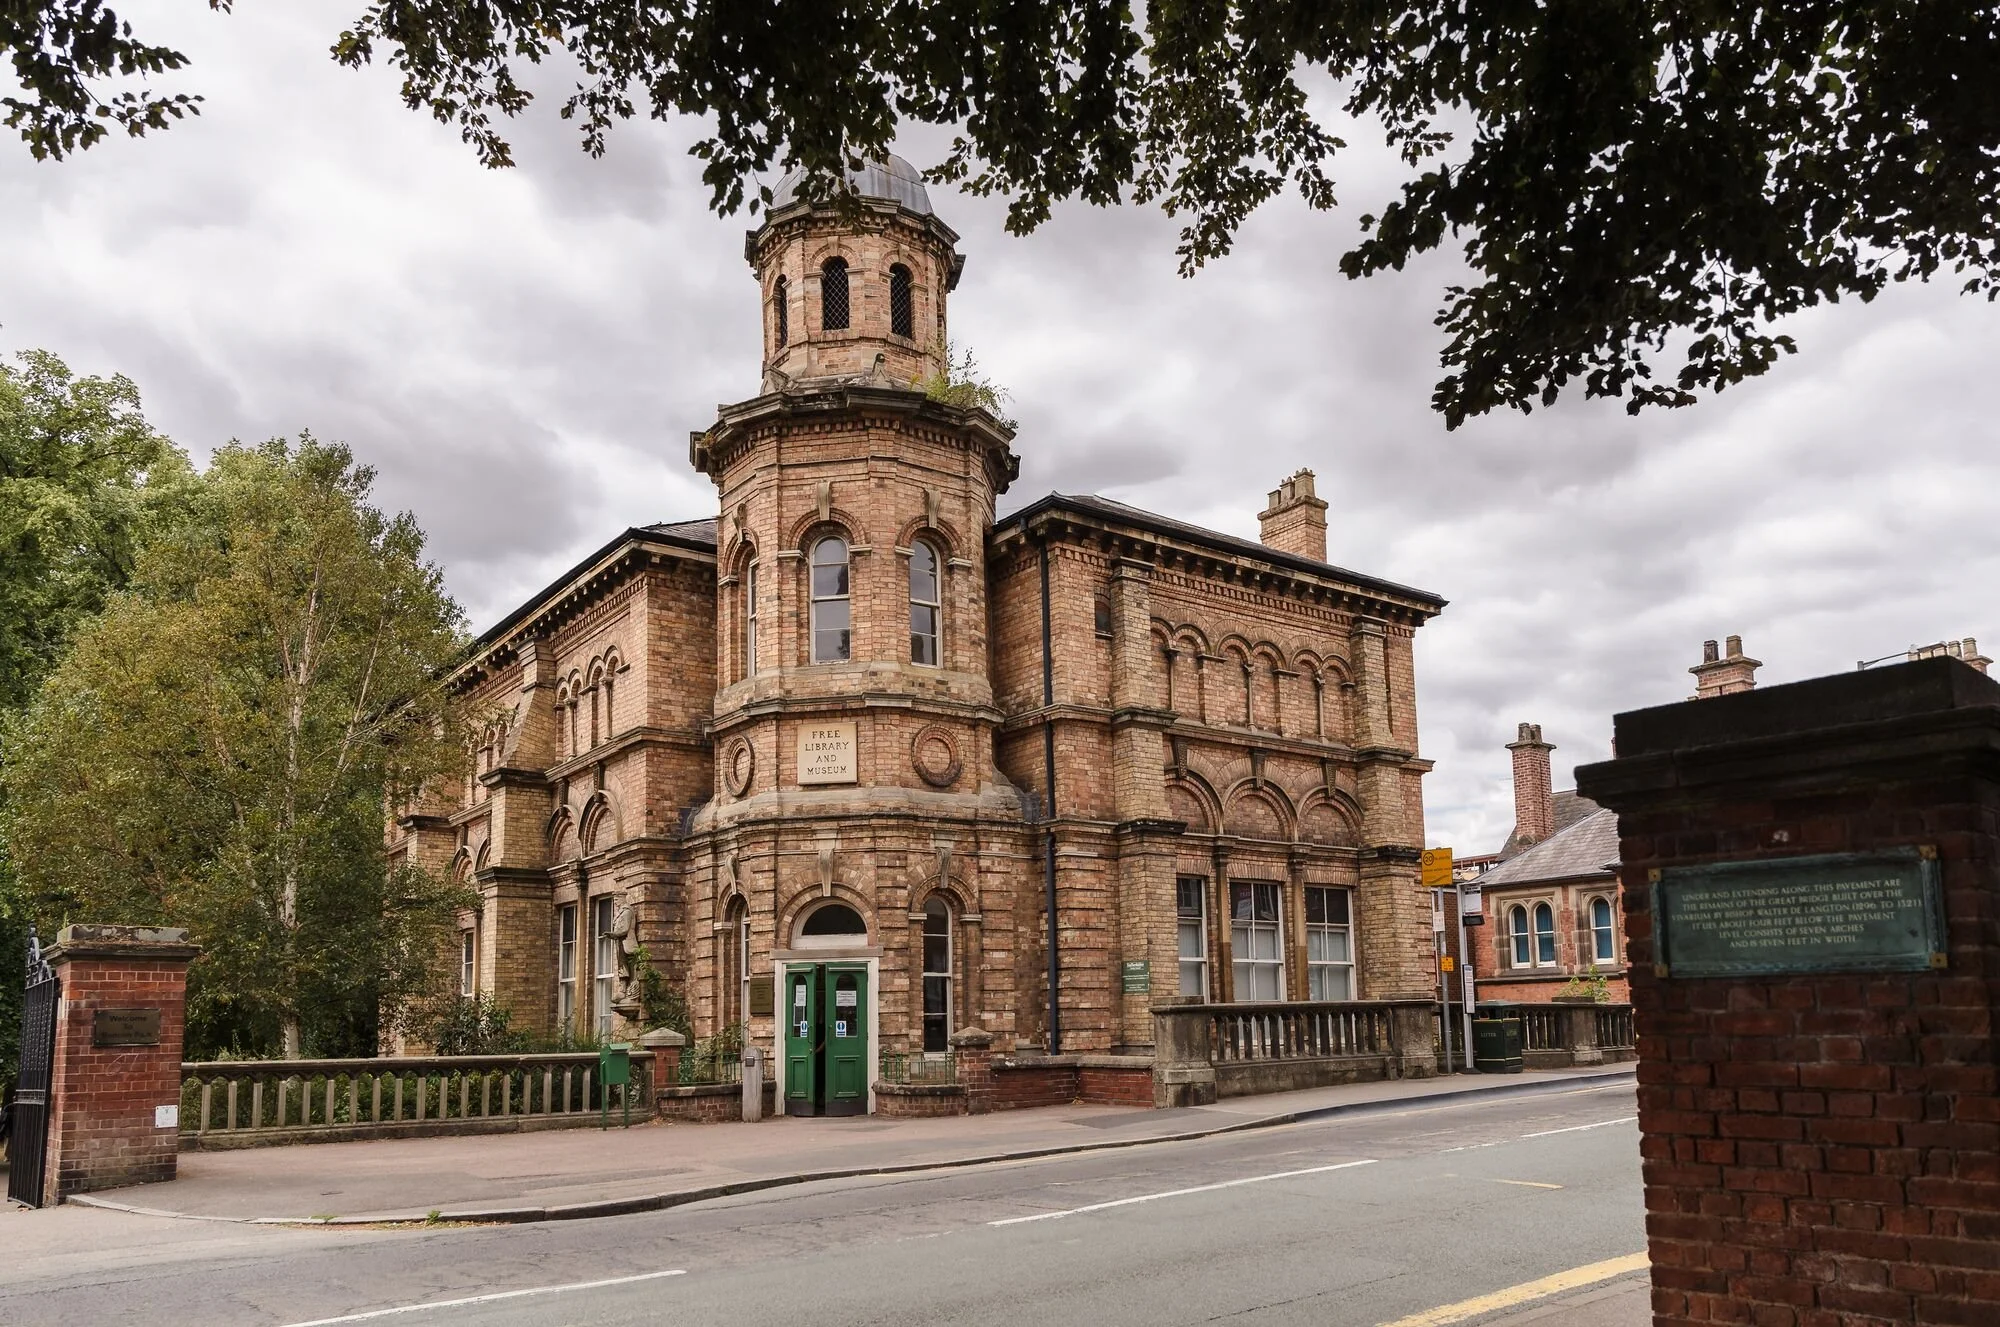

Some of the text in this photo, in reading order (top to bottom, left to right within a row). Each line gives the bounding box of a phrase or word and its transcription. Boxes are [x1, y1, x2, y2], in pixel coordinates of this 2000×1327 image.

[812, 730, 840, 739] FREE
[805, 742, 849, 751] LIBRARY
[807, 766, 846, 775] MUSEUM
[1682, 893, 1709, 901] UNDER
[1732, 887, 1779, 897] EXTENDING
[1781, 885, 1809, 894] ALONG
[1814, 884, 1833, 892] THIS
[1836, 880, 1881, 890] PAVEMENT
[1884, 879, 1901, 887] ARE
[1683, 903, 1697, 911] THE
[1700, 901, 1734, 909] REMAINS
[1750, 898, 1766, 906] THE
[1768, 896, 1796, 904] GREAT
[1799, 894, 1829, 902] BRIDGE
[1832, 892, 1857, 900] BUILT
[1860, 890, 1884, 899] OVER
[1886, 888, 1903, 897] THE
[1713, 911, 1722, 919] BY
[1757, 907, 1788, 915] WALTER
[1791, 906, 1801, 914] DE
[1804, 904, 1850, 913] LANGTON
[1881, 900, 1894, 909] TO
[1692, 922, 1700, 930] IT
[1720, 920, 1746, 928] ABOUT
[1749, 918, 1772, 927] FOUR
[1774, 917, 1792, 925] FEET
[1795, 915, 1823, 925] BELOW
[1826, 914, 1844, 922] THE
[1848, 911, 1895, 921] PAVEMENT
[1719, 923, 1864, 938] LEVEL CONSISTS OF SEVEN ARCHES
[1729, 940, 1748, 948] AND
[1760, 938, 1785, 947] SEVEN
[1787, 937, 1807, 945] FEET
[1824, 935, 1856, 944] WIDTH
